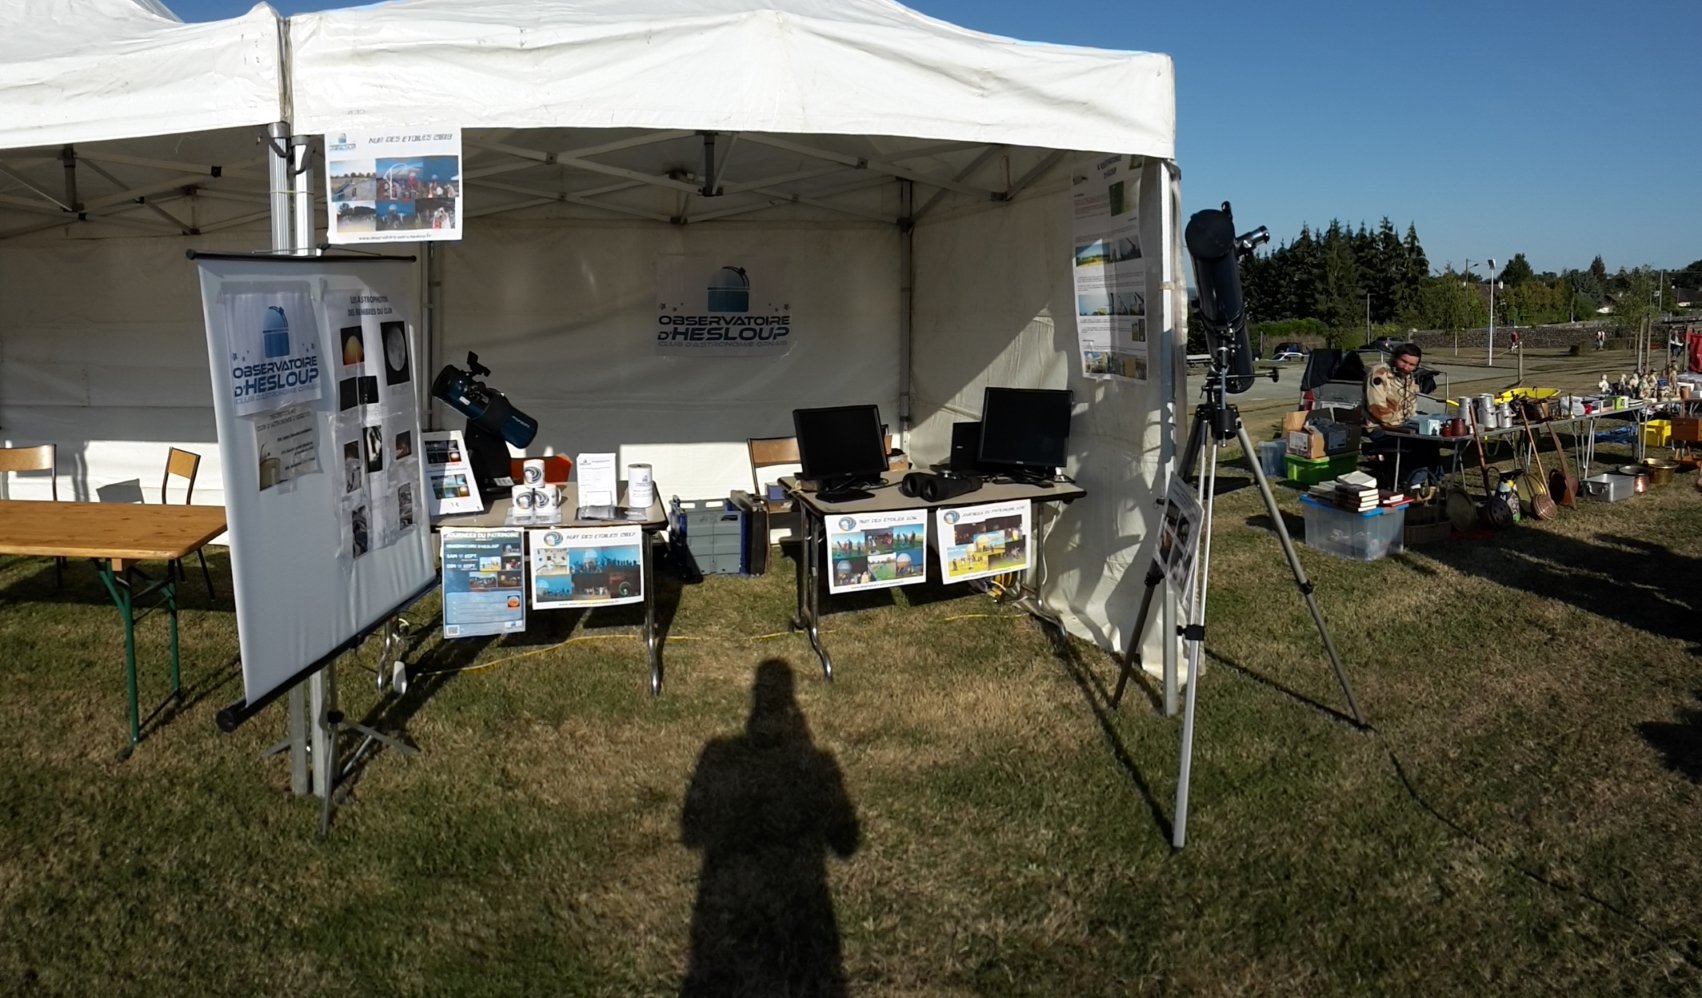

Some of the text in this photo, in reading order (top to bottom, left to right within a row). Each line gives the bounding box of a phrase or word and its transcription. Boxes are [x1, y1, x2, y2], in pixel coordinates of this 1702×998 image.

[368, 136, 384, 144] NUIT
[385, 135, 400, 143] DES
[658, 315, 790, 327] OBSERVATOIRE
[657, 326, 790, 342] D'HESLOUP
[232, 355, 318, 379] OBSERVATOIRE
[233, 367, 319, 398] D'HESLOUP
